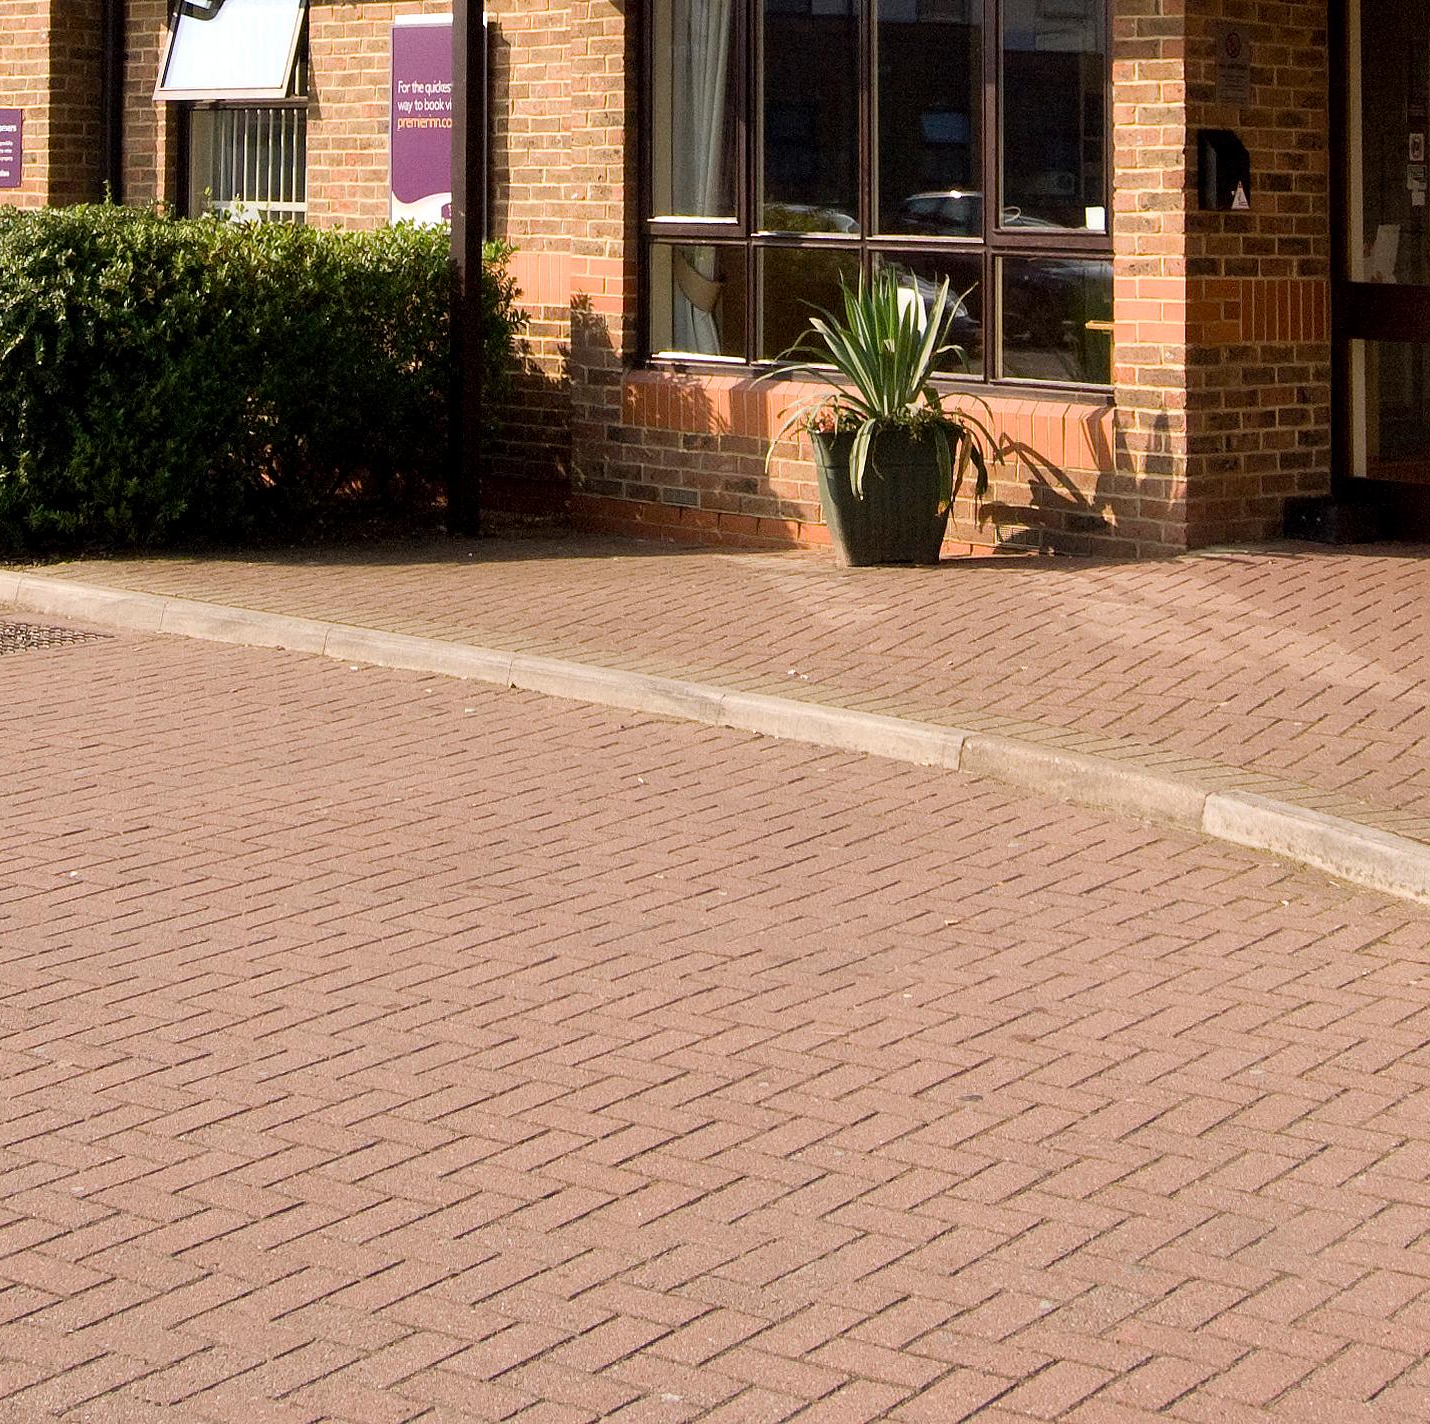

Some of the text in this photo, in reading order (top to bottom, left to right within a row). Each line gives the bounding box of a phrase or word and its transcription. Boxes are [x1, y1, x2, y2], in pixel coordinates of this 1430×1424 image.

[398, 80, 452, 96] For the quickes
[397, 101, 413, 114] way
[414, 99, 423, 111] to
[424, 98, 444, 111] book
[397, 113, 453, 131] premierinn.co
